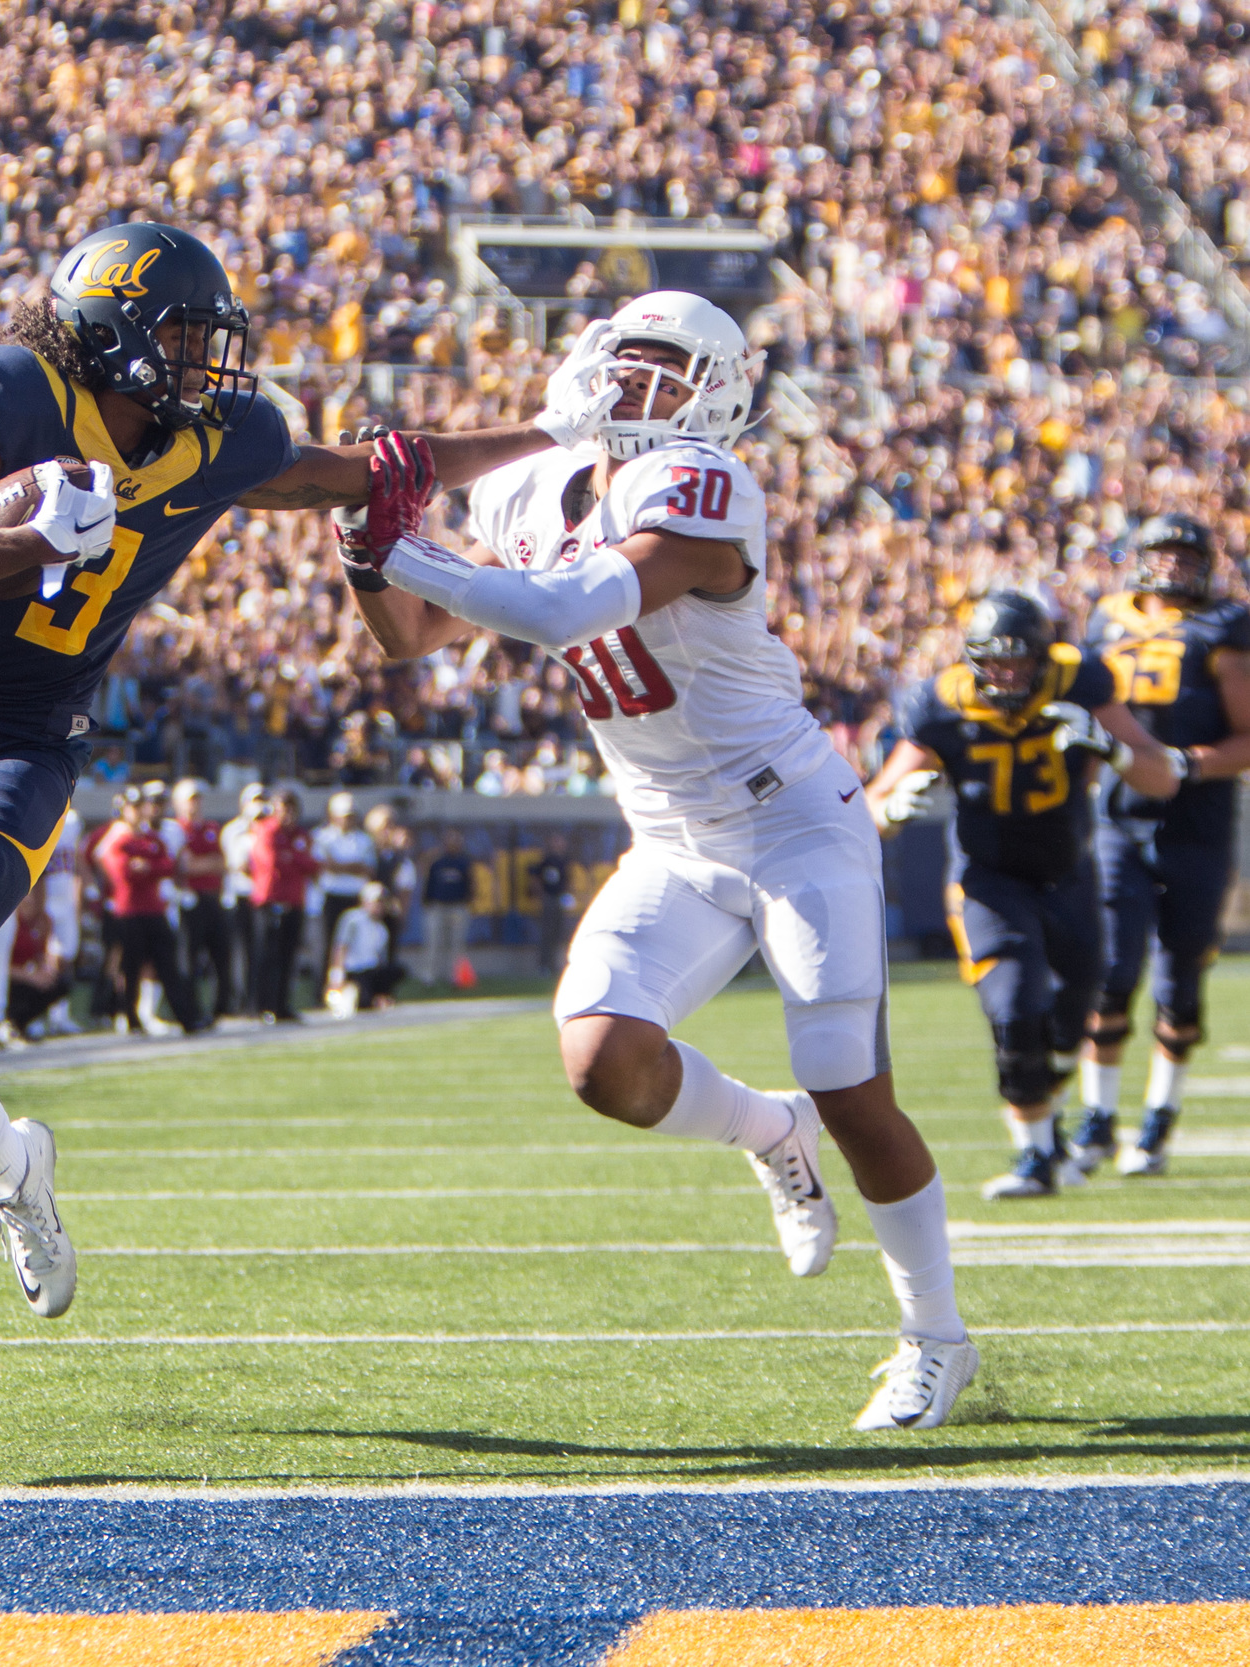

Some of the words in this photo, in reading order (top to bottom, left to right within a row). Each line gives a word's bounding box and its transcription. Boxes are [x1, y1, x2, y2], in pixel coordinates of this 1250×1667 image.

[78, 239, 161, 298] Cal
[115, 477, 141, 500] Cal
[667, 466, 732, 521] 30
[15, 525, 144, 656] 3
[75, 719, 84, 729] 42
[755, 776, 768, 788] 40
[966, 735, 1070, 815] 73
